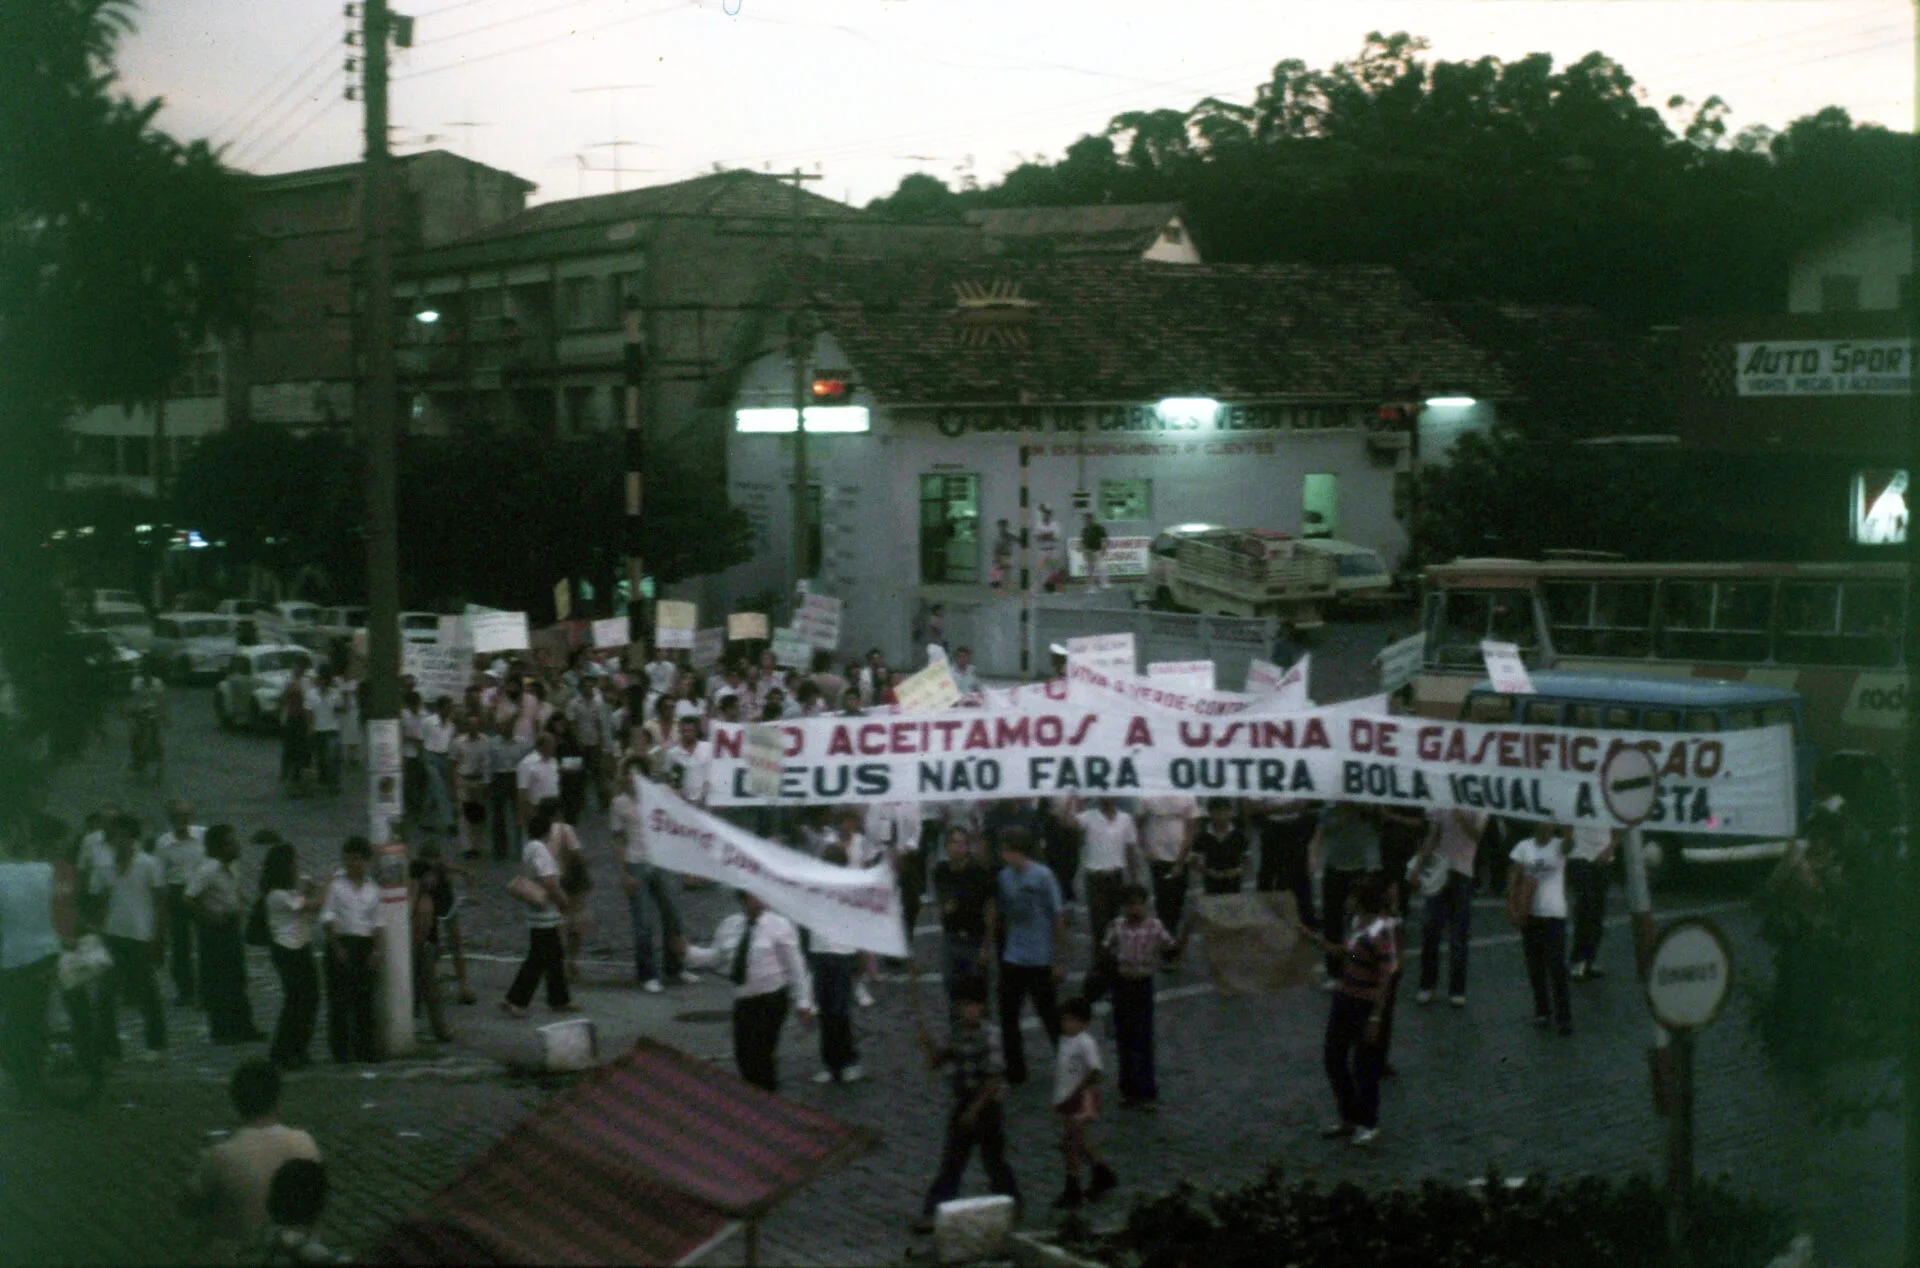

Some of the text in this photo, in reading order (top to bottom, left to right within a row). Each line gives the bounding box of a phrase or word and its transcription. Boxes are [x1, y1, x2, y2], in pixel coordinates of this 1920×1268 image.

[1743, 344, 1819, 375] AUTO
[714, 726, 804, 758] NO
[826, 713, 1096, 754] ACEITAMOS
[1122, 716, 1153, 747] A
[1179, 716, 1331, 750] USINA
[1348, 717, 1399, 757] DE
[917, 756, 998, 793] NÃO
[1027, 749, 1138, 791] FARÁ
[1169, 757, 1315, 792] OUTRA
[1342, 760, 1432, 801] BOLA
[1448, 773, 1552, 816] IGUAL
[1575, 781, 1596, 818] A
